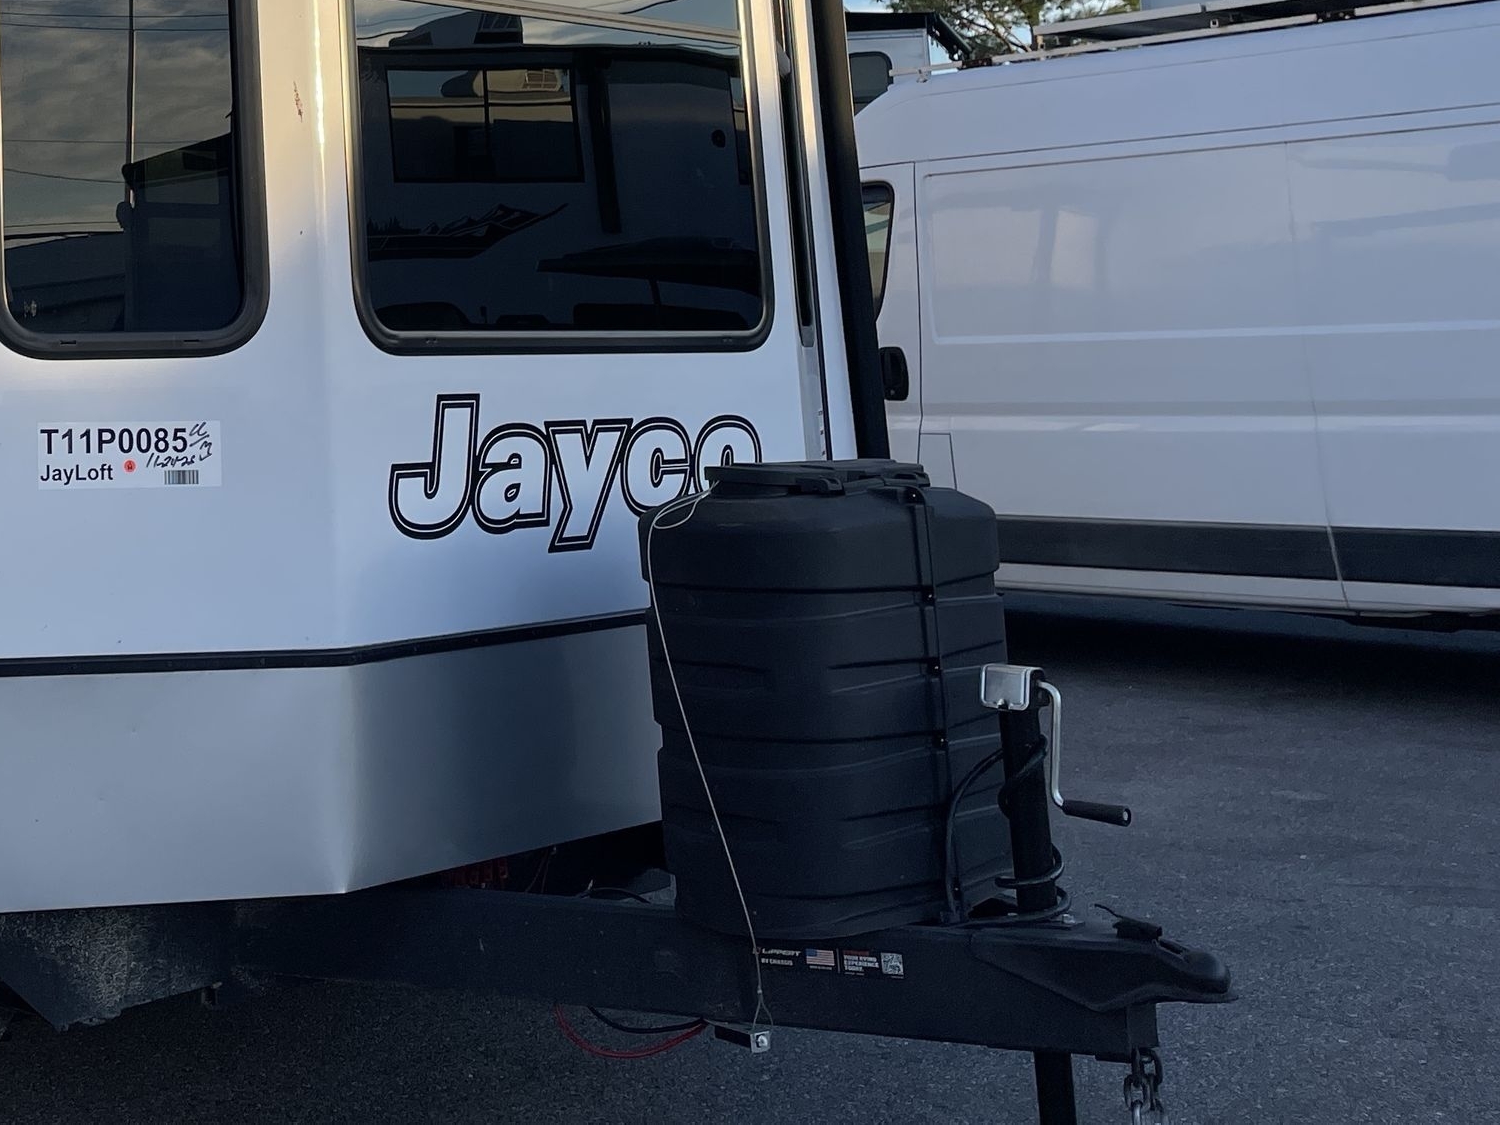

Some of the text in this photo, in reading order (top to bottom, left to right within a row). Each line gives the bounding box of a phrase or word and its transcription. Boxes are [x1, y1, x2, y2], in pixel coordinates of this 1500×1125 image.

[40, 427, 188, 454] T11P0085
[40, 464, 114, 485] JayLoft
[388, 393, 762, 553] Jayco
